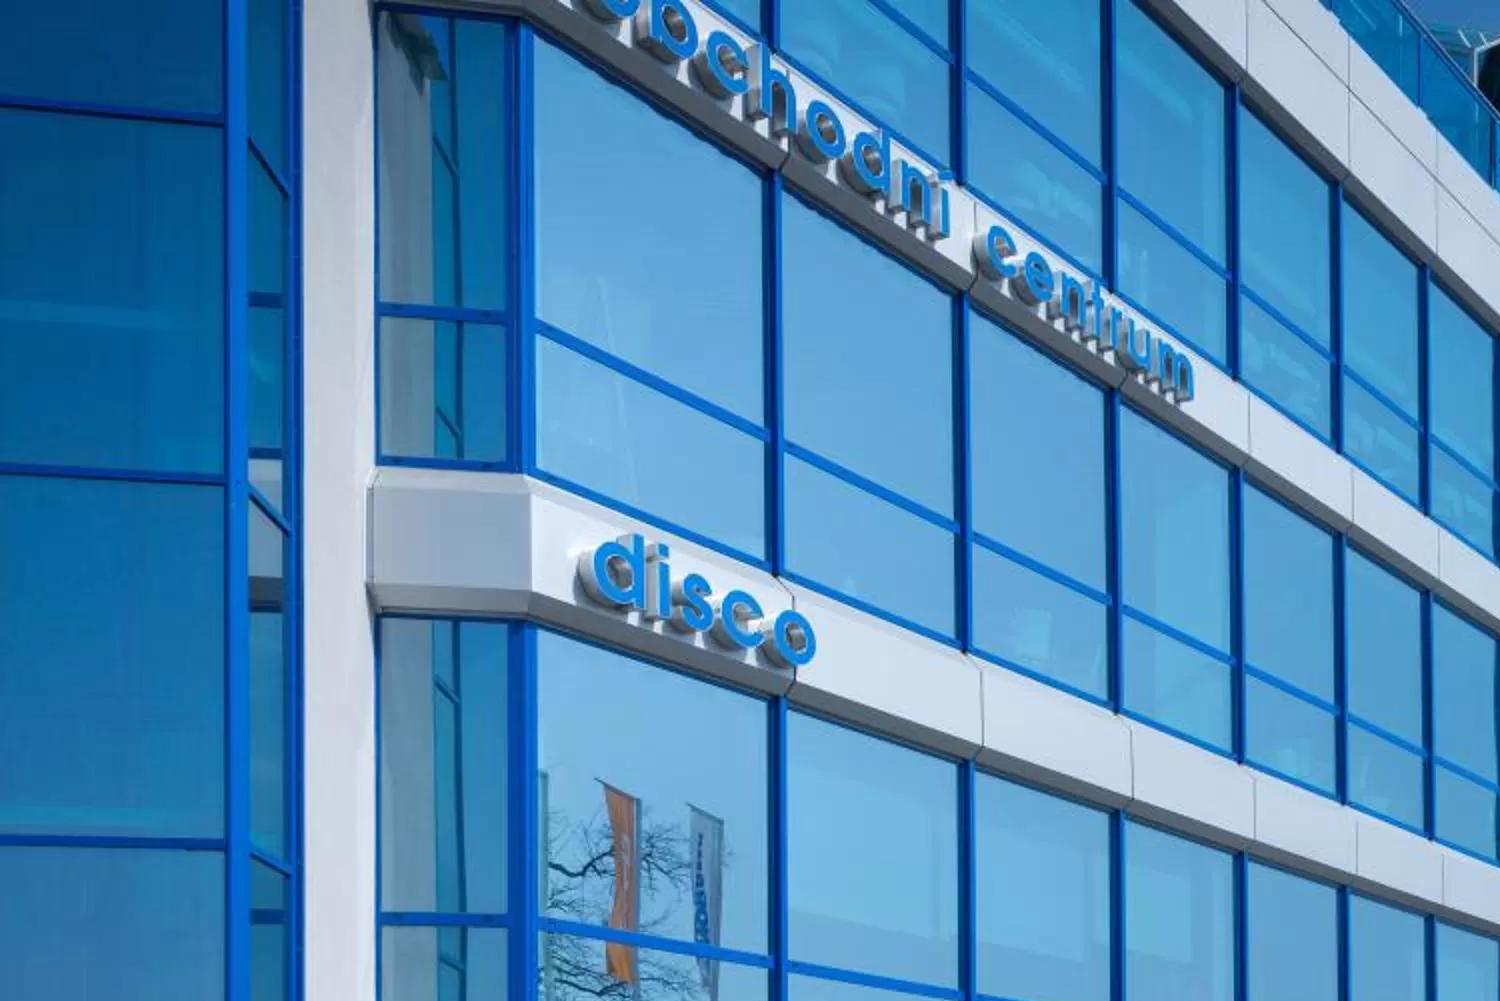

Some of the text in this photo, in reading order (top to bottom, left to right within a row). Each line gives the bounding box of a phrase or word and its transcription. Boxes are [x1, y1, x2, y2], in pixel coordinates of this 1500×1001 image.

[602, 0, 1195, 401] bchodní centrum
[593, 533, 817, 666] disco
